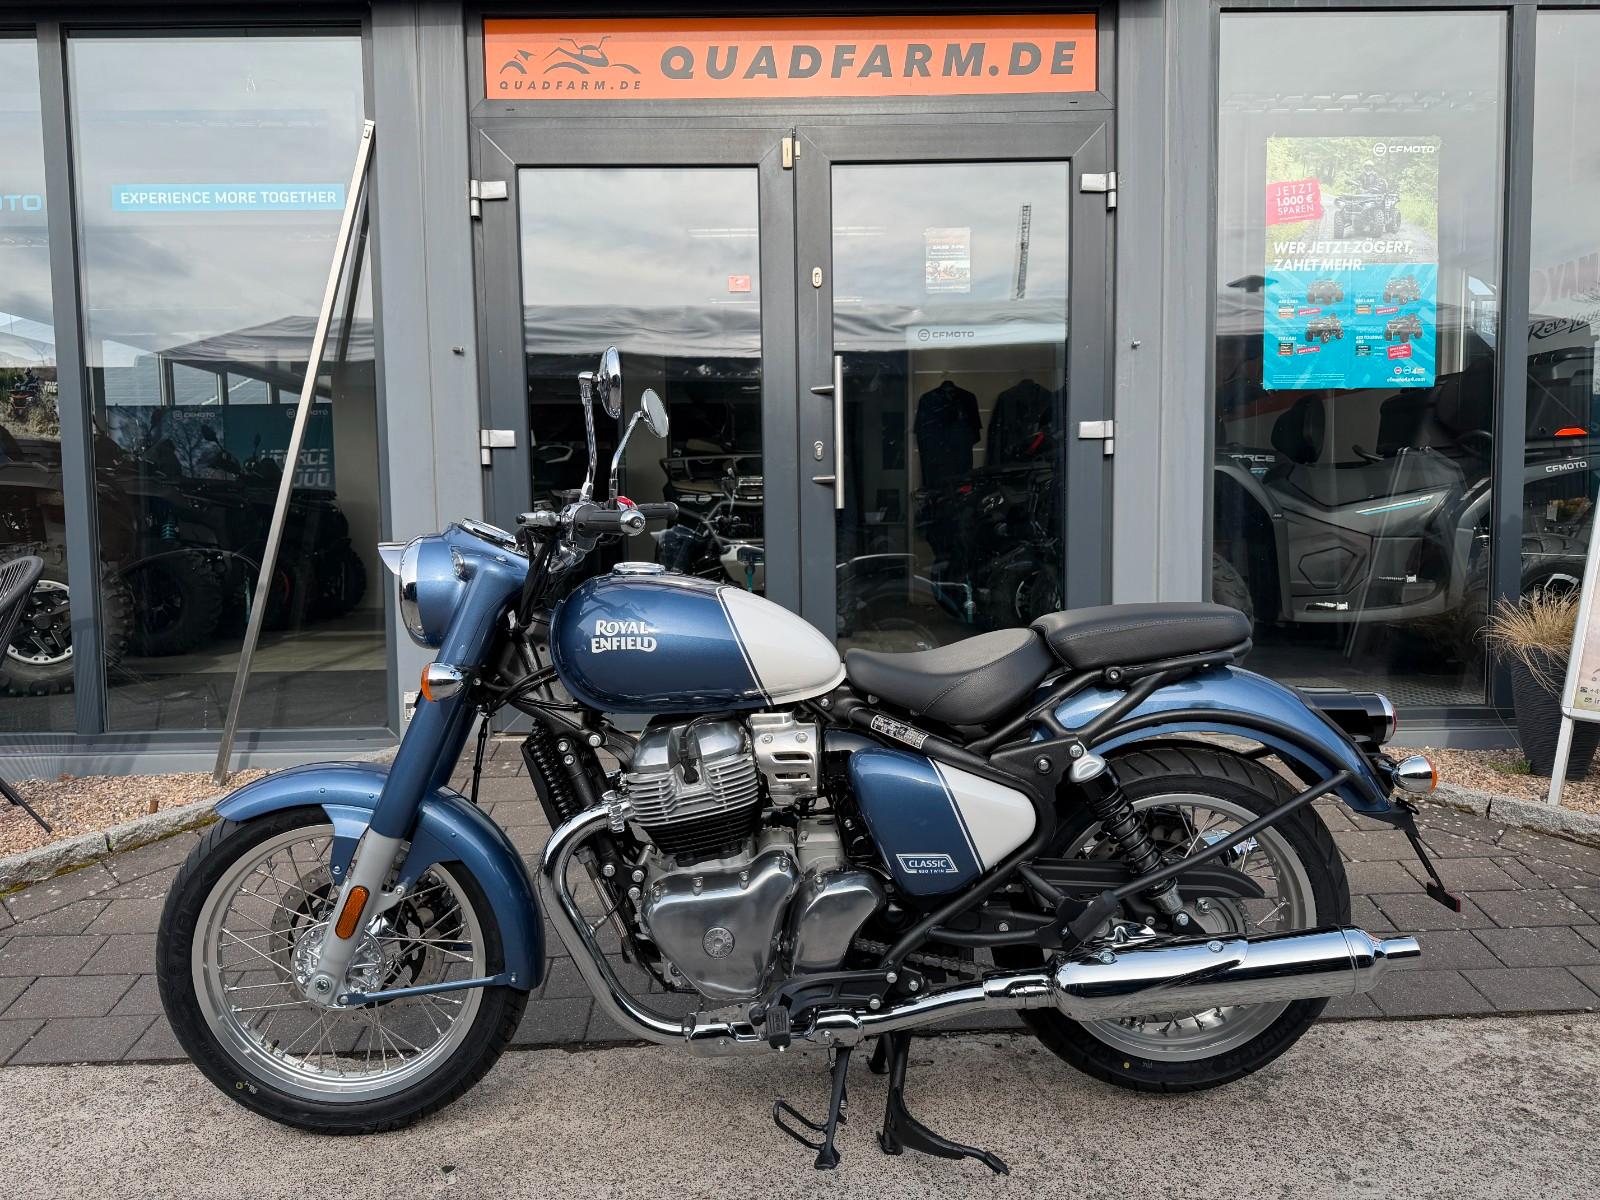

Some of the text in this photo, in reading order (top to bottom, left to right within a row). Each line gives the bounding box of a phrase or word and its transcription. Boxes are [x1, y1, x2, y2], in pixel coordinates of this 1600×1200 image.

[660, 41, 1077, 80] QUADFARM.DE
[499, 80, 642, 90] QUADFARM.DE
[1388, 145, 1435, 153] CFMOTO
[1275, 183, 1312, 197] JETZT
[0, 194, 42, 211] TO
[120, 190, 337, 205] EXPERIENCE MORE TOGETHER
[1277, 203, 1314, 216] SPAREN
[1273, 237, 1414, 255] WER JETZT ZÖGERT,
[1319, 258, 1366, 272] MEHR.
[931, 330, 975, 338] CFMOTO
[1545, 461, 1588, 473] CFMOTO
[595, 619, 649, 637] ROYAL
[591, 636, 657, 653] ENFIELD
[908, 859, 947, 868] CLASSIC
